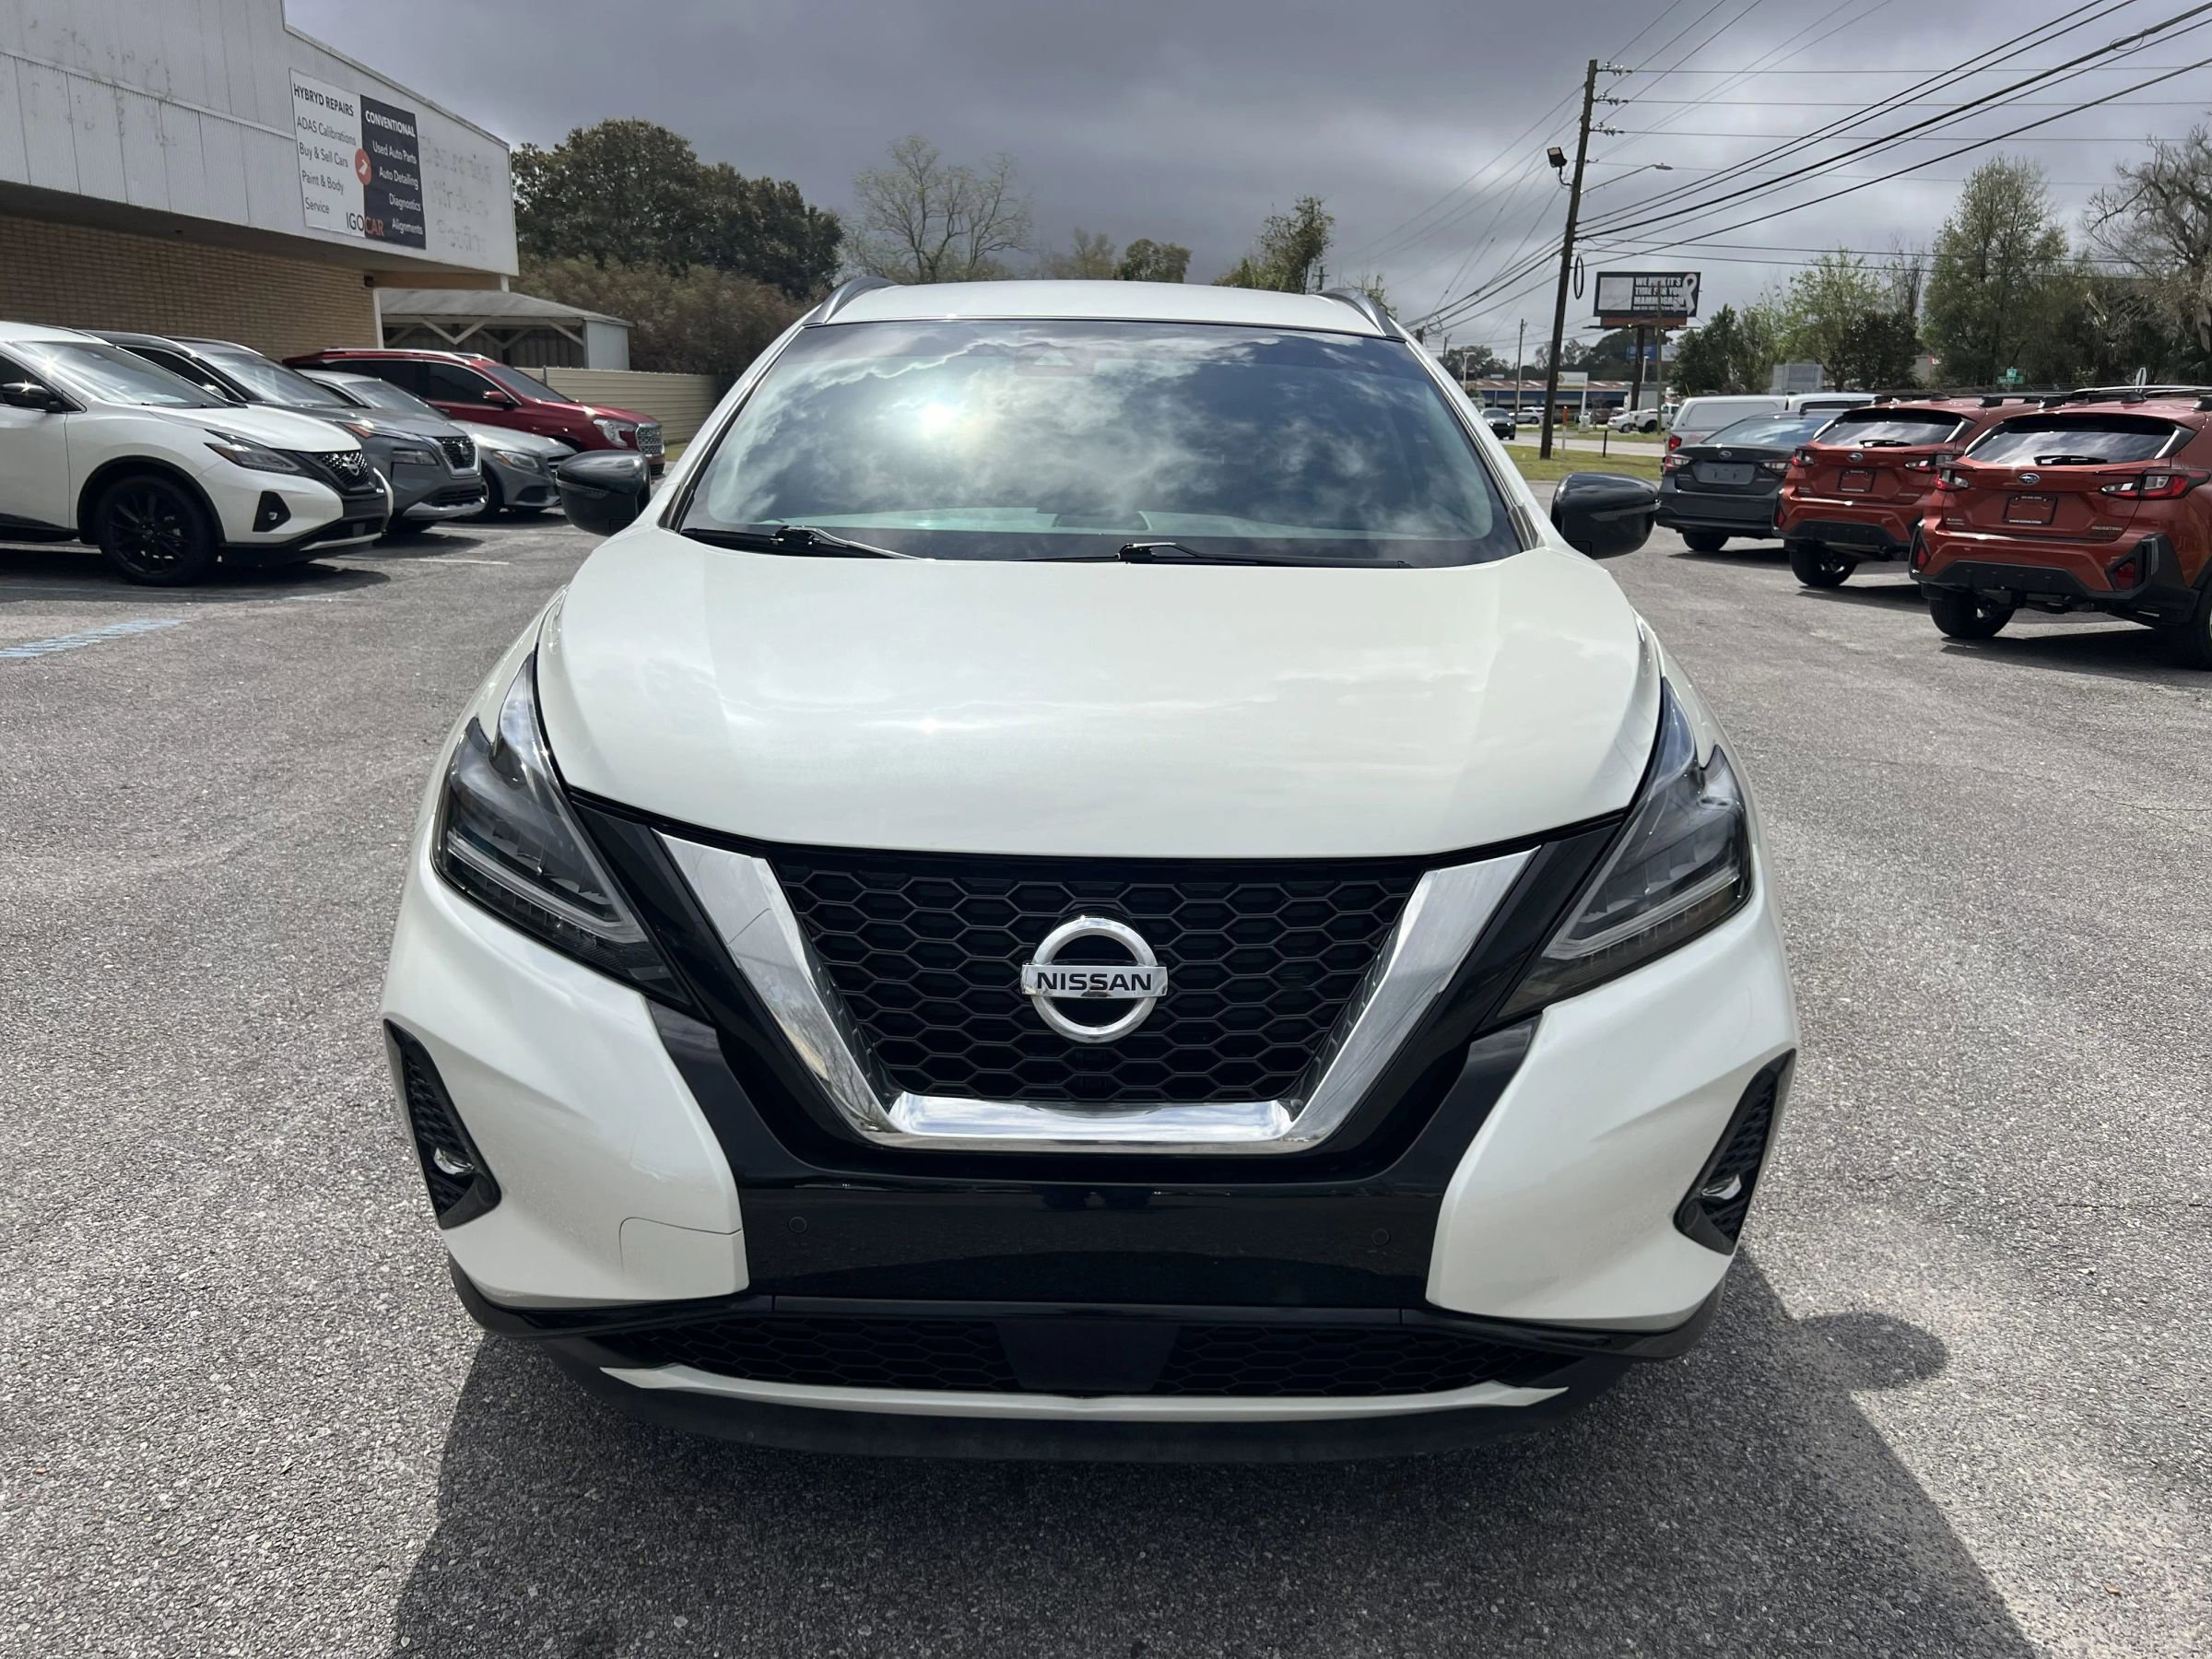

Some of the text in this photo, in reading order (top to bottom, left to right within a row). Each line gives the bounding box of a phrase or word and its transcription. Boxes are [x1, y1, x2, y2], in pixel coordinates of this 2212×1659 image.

[293, 84, 354, 117] HYBRYD REPAIRS
[297, 115, 357, 147] ADAS Calibrations
[365, 110, 416, 138] CONVENTIONAL
[300, 142, 348, 169] Buy & Sell Cars
[373, 140, 418, 164] Used Auto Parts
[302, 170, 344, 195] Paint & Body
[379, 166, 418, 191] Auto Detailing
[305, 196, 330, 215] Service
[389, 193, 421, 212] Diagnostics
[347, 212, 384, 237] IGOCAR
[392, 218, 423, 236] Alignments
[1635, 277, 1648, 286] WE
[1037, 972, 1151, 991] NISSAN
